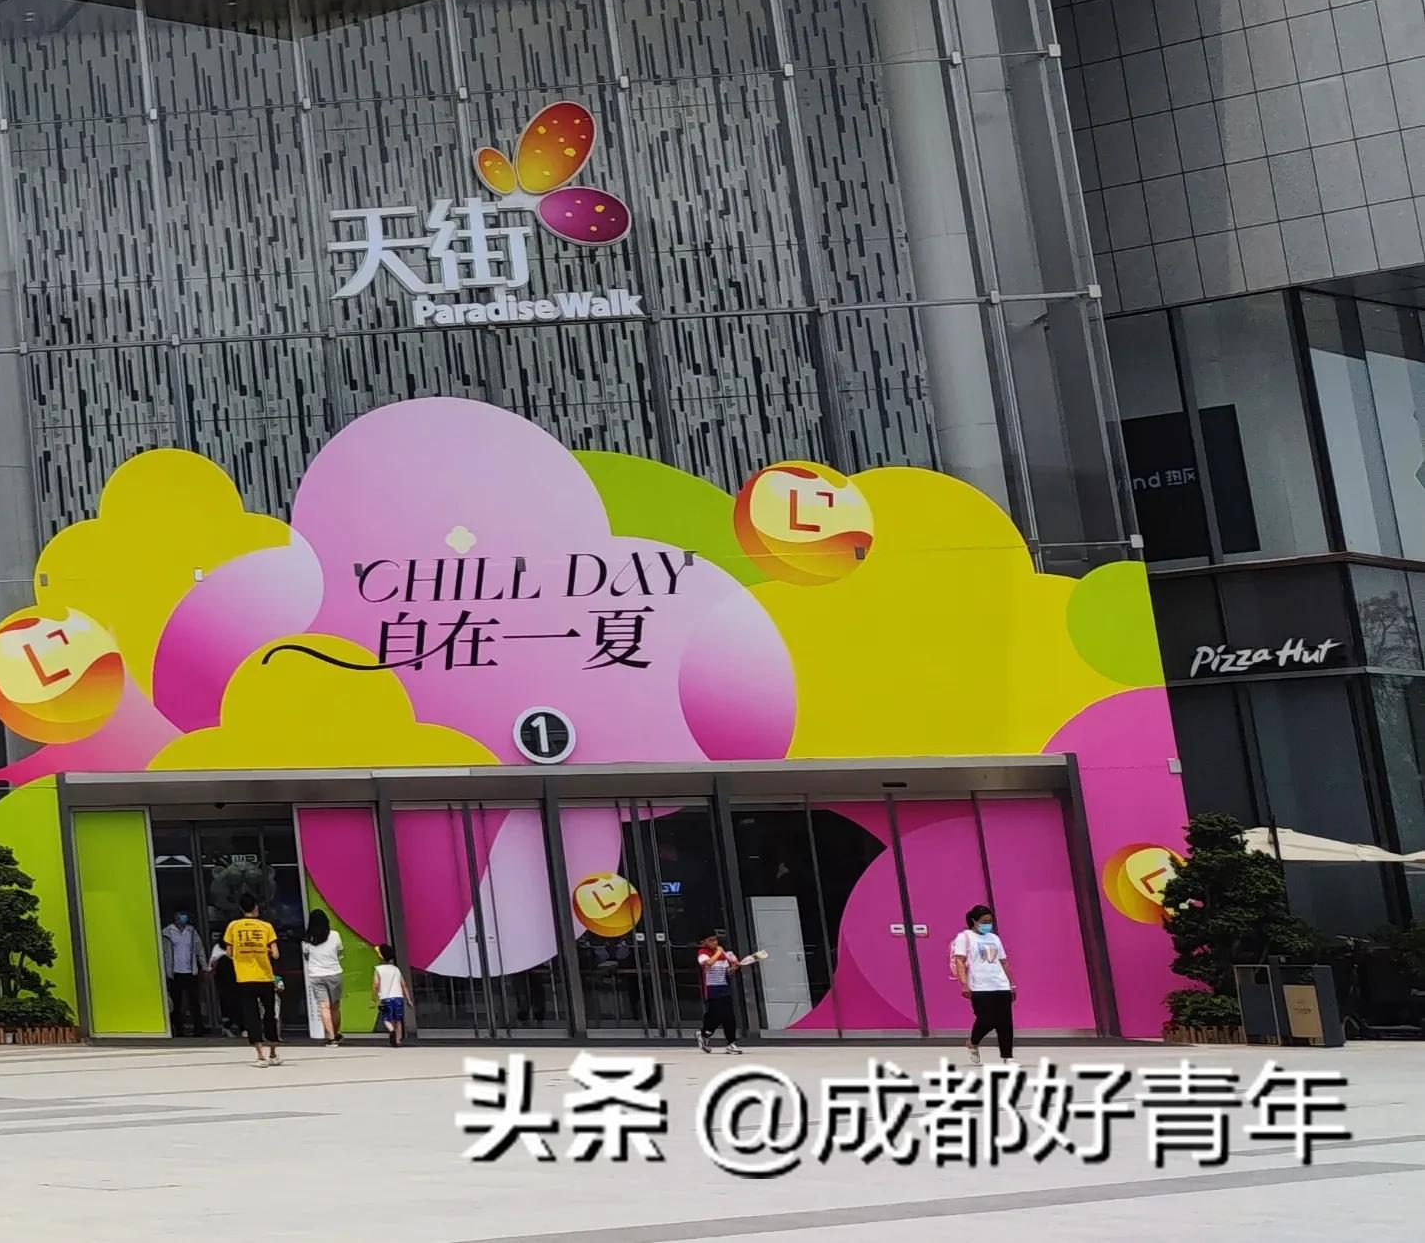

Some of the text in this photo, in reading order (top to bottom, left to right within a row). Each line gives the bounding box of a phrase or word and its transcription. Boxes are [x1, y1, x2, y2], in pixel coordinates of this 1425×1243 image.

[327, 197, 532, 300] 天街
[413, 288, 643, 328] Paradise Walk
[357, 550, 698, 603] CHILL DAY
[378, 605, 655, 671] 自在一夏
[1189, 637, 1343, 679] Pizza Hut
